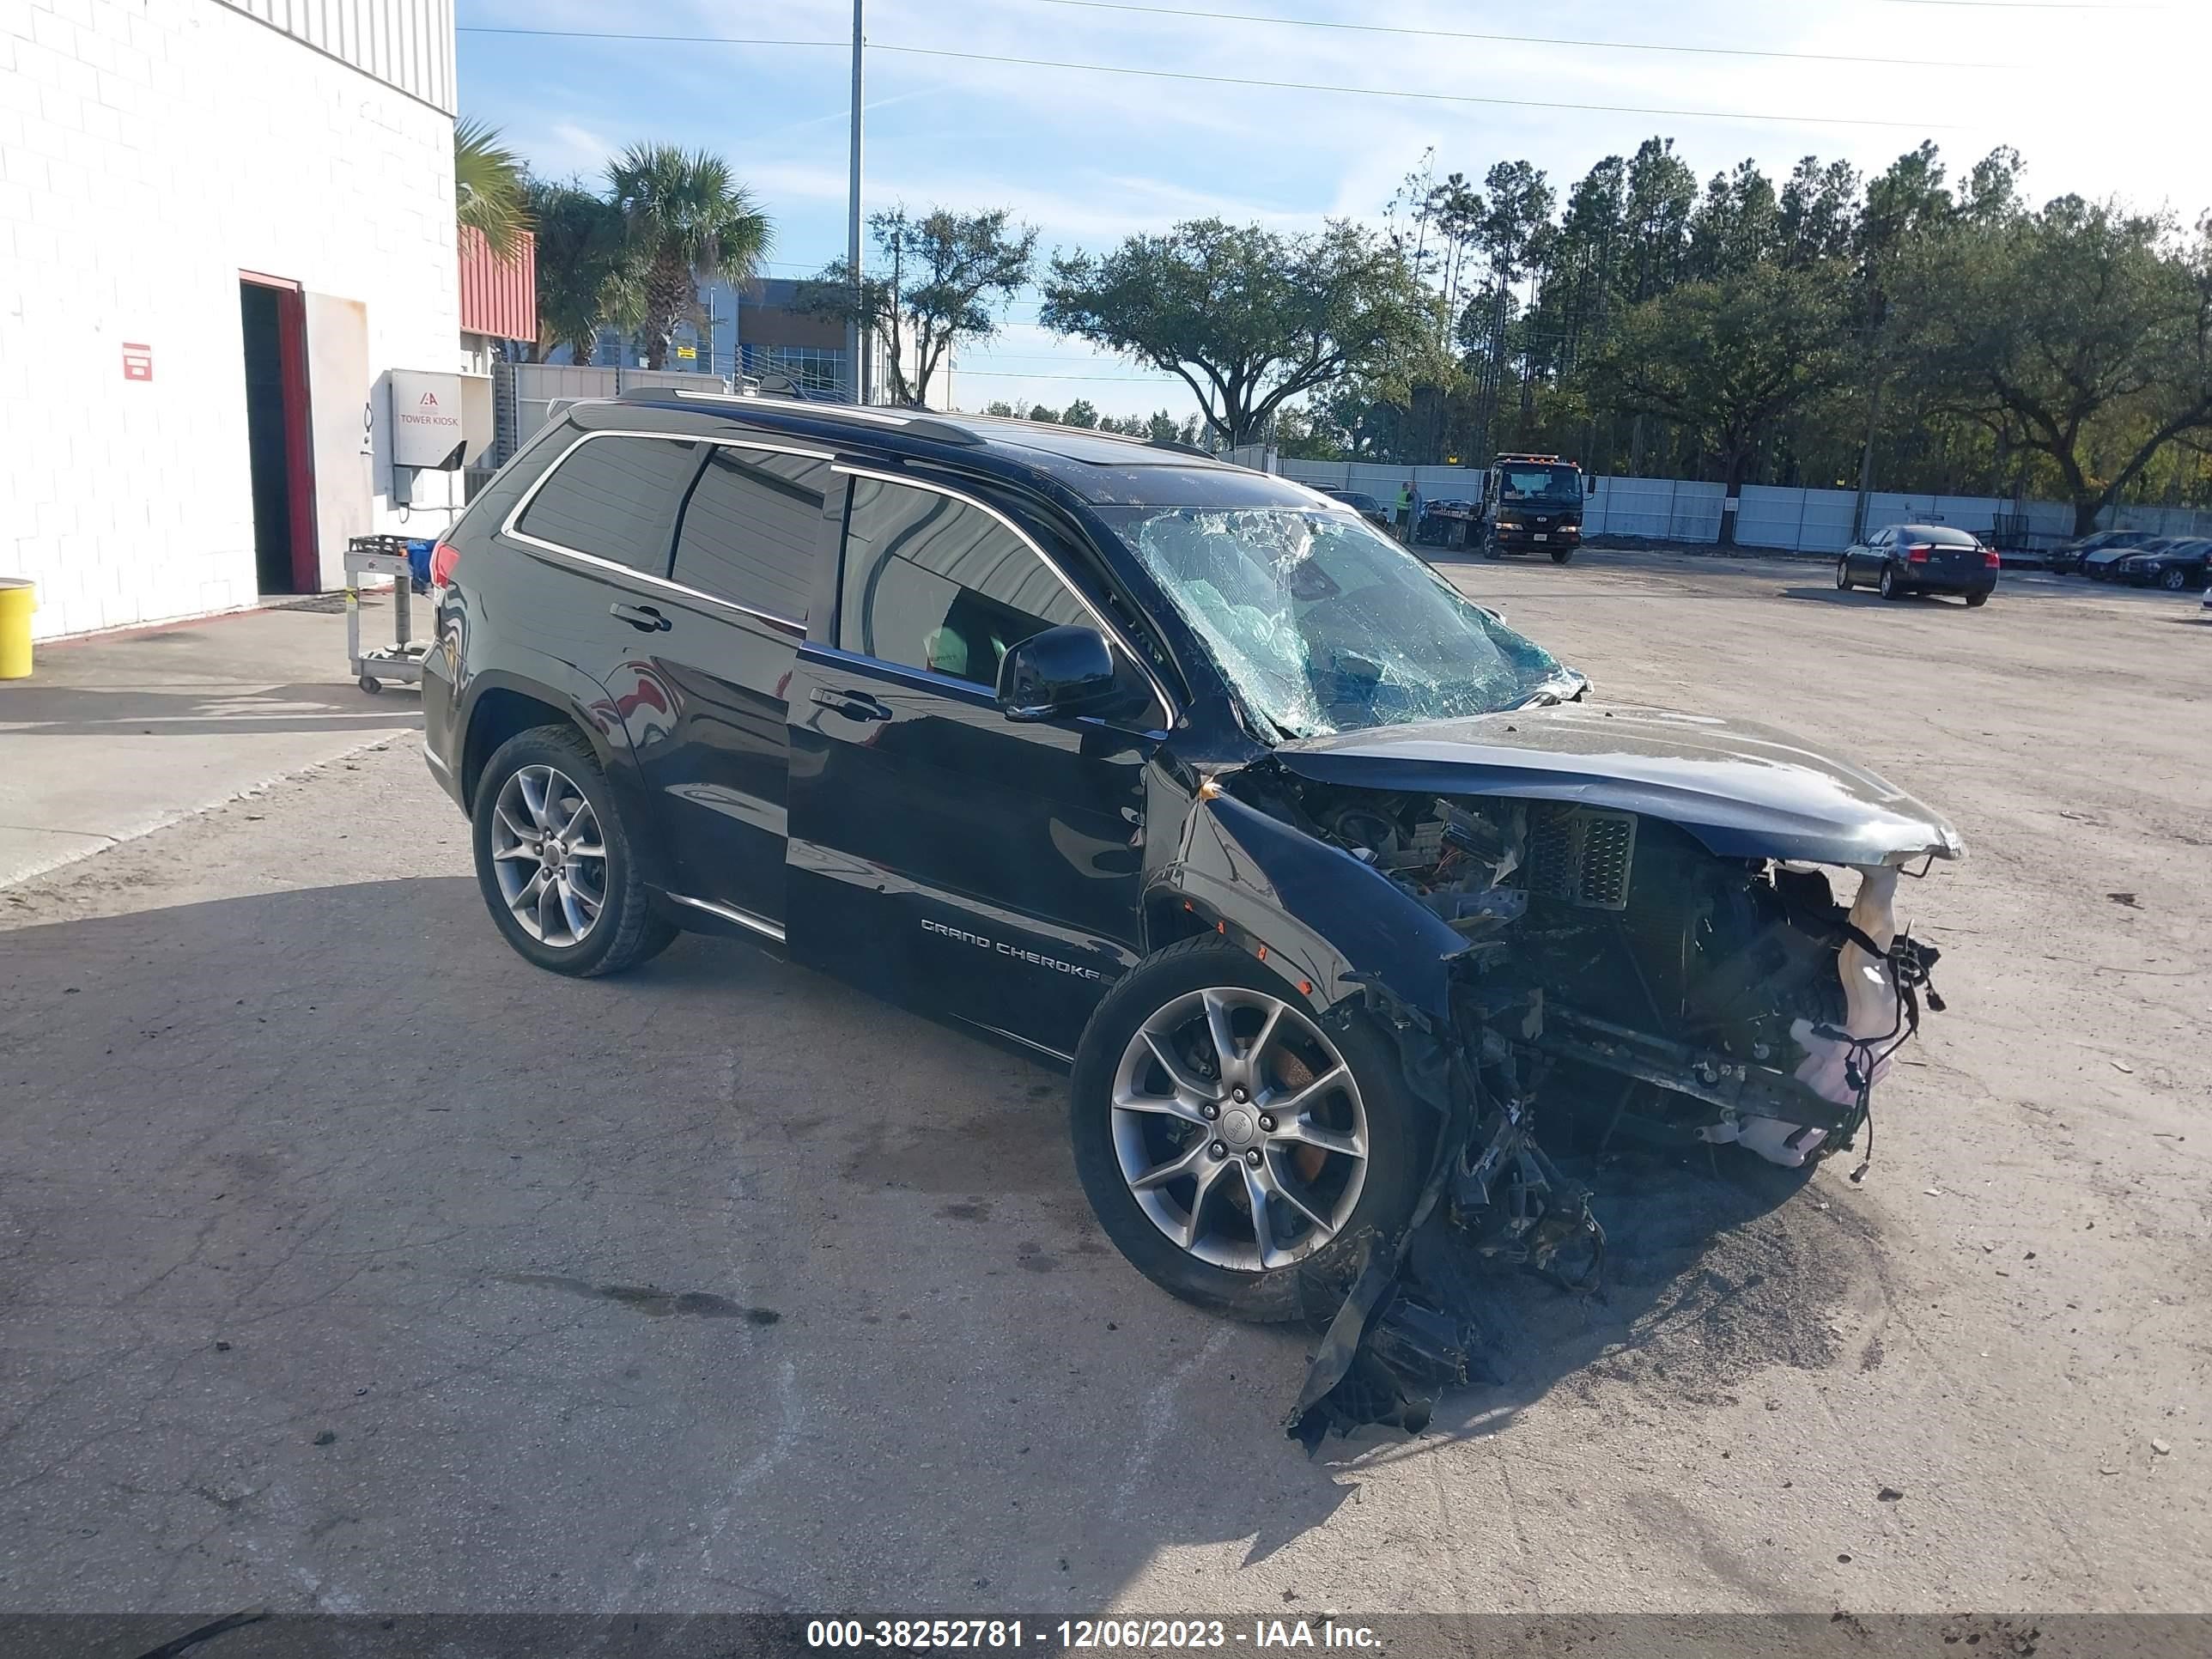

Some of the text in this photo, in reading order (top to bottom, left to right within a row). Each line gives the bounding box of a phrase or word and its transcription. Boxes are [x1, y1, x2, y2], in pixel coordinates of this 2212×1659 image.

[401, 414, 459, 427] TOWER KIOSK
[921, 919, 990, 948] GRAND
